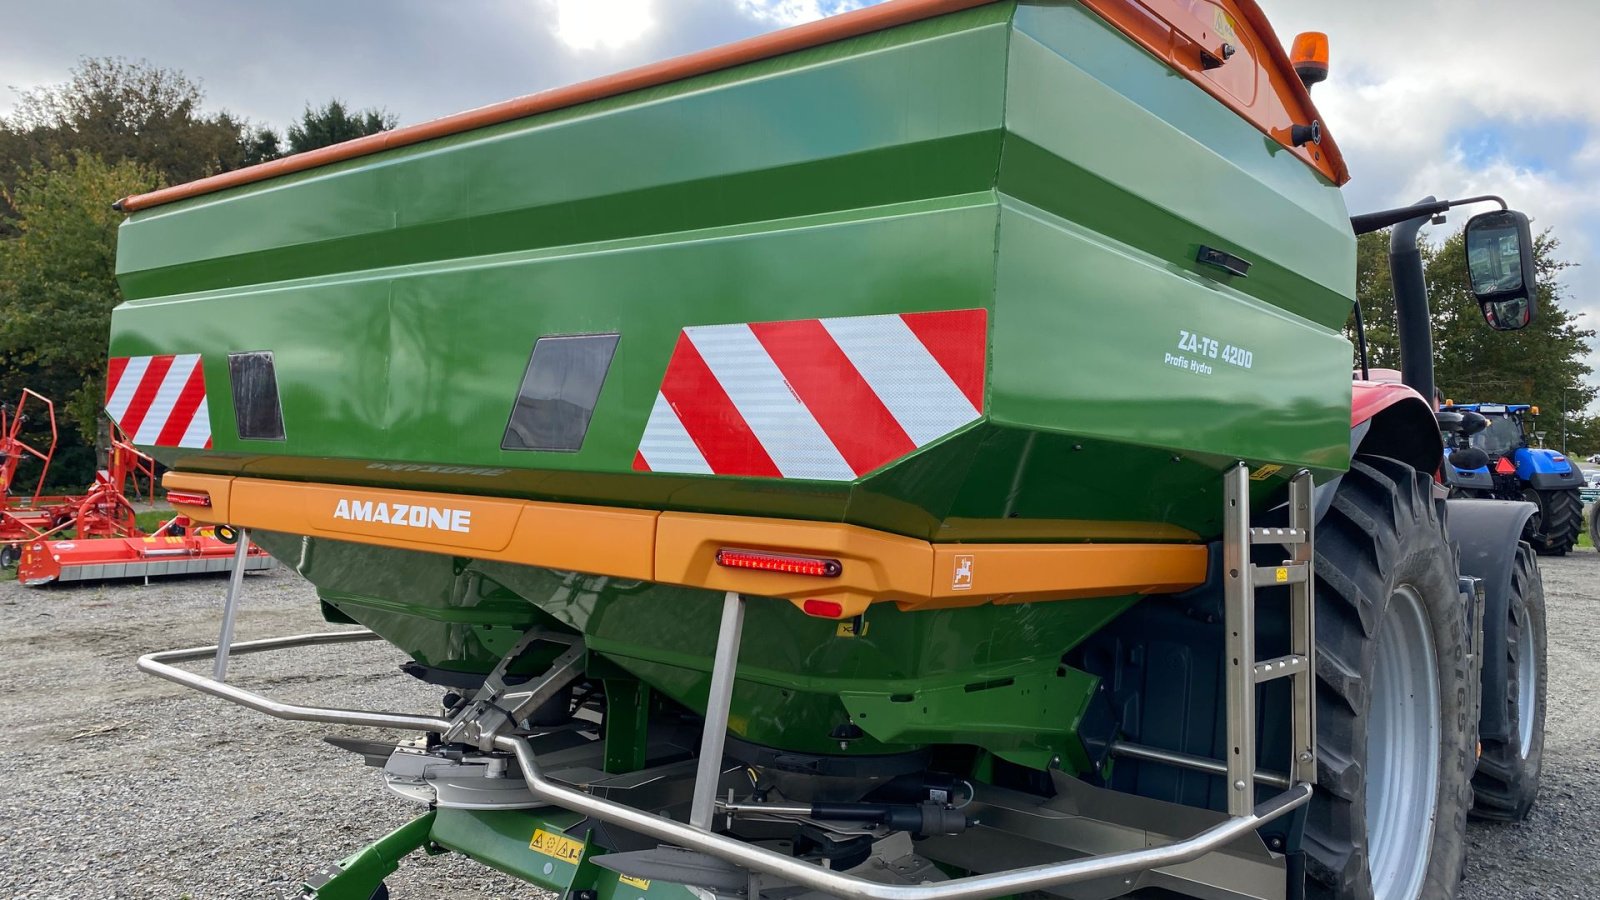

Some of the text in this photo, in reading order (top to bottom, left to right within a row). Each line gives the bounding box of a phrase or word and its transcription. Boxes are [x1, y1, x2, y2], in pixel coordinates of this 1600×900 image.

[1164, 352, 1212, 375] Profis Hydro
[1178, 330, 1253, 369] ZA-TS 4200
[333, 499, 471, 533] AMAZONE
